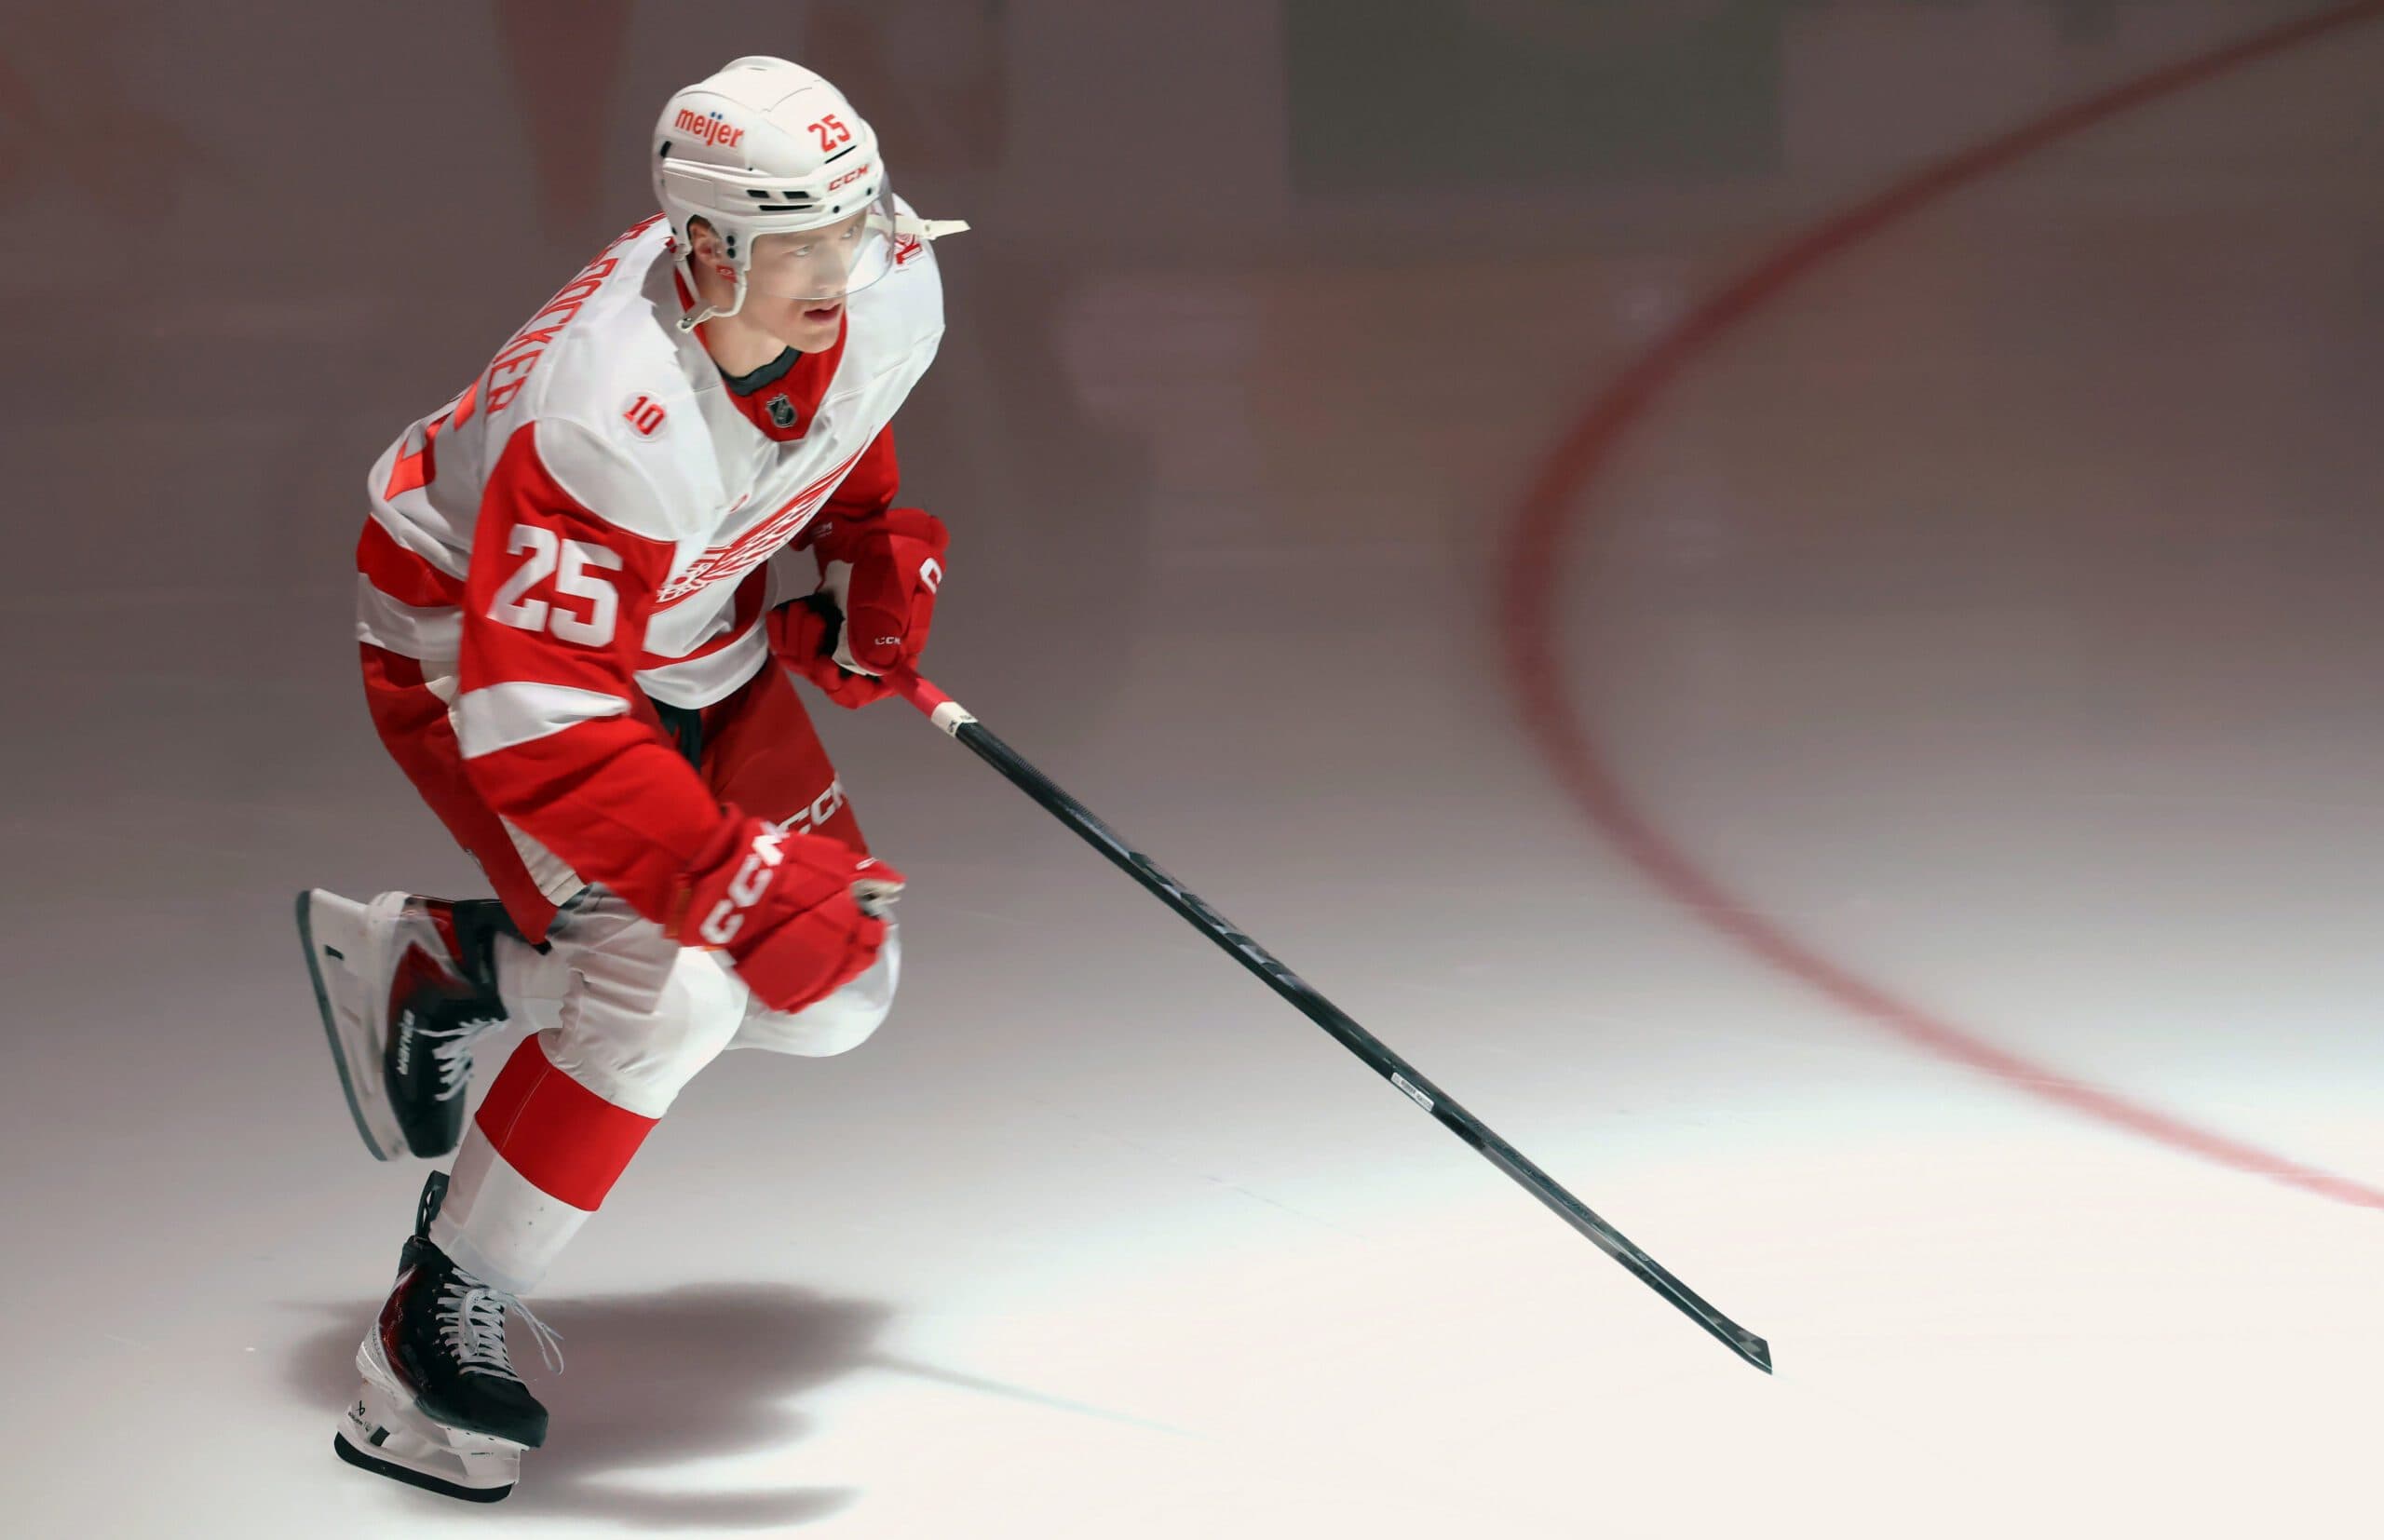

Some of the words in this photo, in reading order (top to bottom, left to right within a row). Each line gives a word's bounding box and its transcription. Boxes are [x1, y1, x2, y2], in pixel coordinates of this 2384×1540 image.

[674, 108, 745, 148] meijer
[807, 114, 850, 152] 25
[829, 164, 870, 191] CCM
[623, 396, 667, 437] 10
[484, 523, 623, 648] 25
[699, 821, 791, 944] CCM
